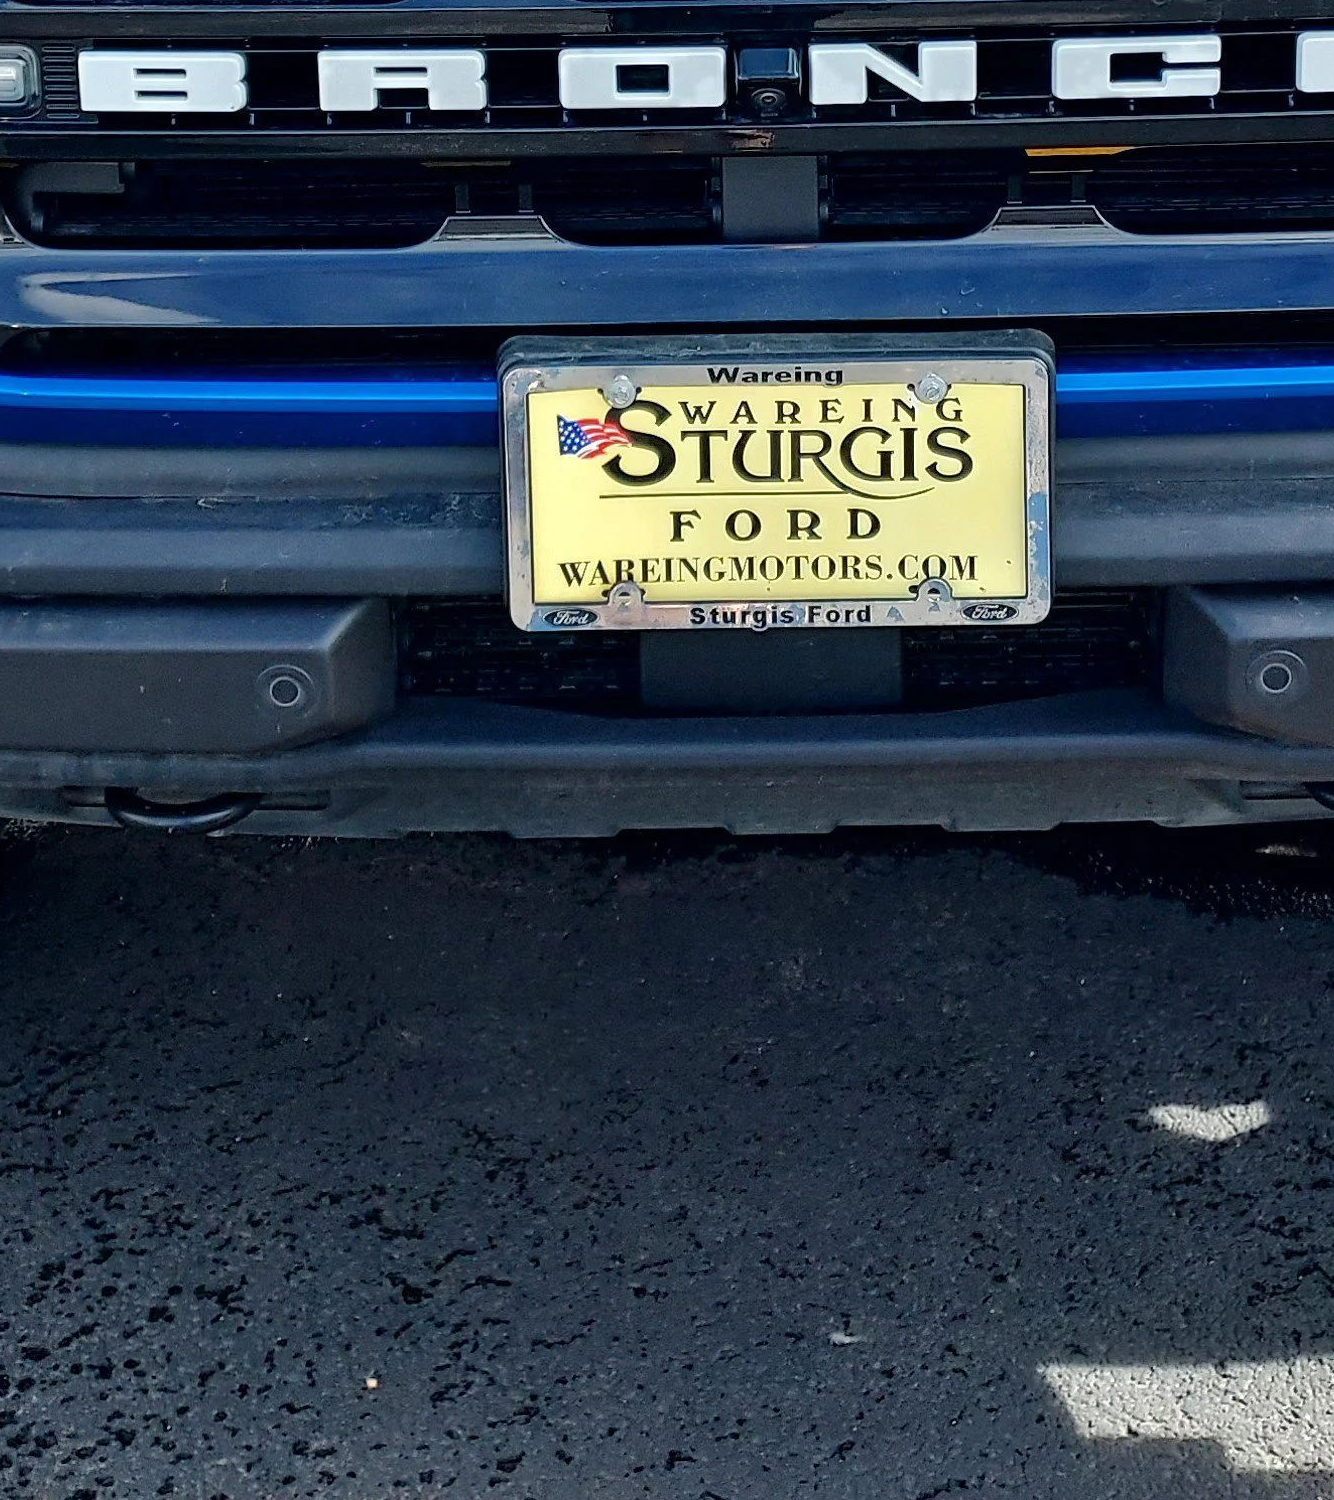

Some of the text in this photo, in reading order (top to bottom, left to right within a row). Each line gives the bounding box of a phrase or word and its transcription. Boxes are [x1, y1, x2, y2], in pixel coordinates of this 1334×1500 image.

[707, 366, 843, 385] Wareing
[677, 397, 964, 425] WAREING
[601, 400, 974, 499] STURGIS
[669, 509, 881, 542] FORD
[557, 555, 979, 587] WAREINGMOTORS.COM
[551, 609, 590, 626] Ford
[690, 605, 872, 629] Sturgis Ford
[969, 604, 1009, 621] Ford
